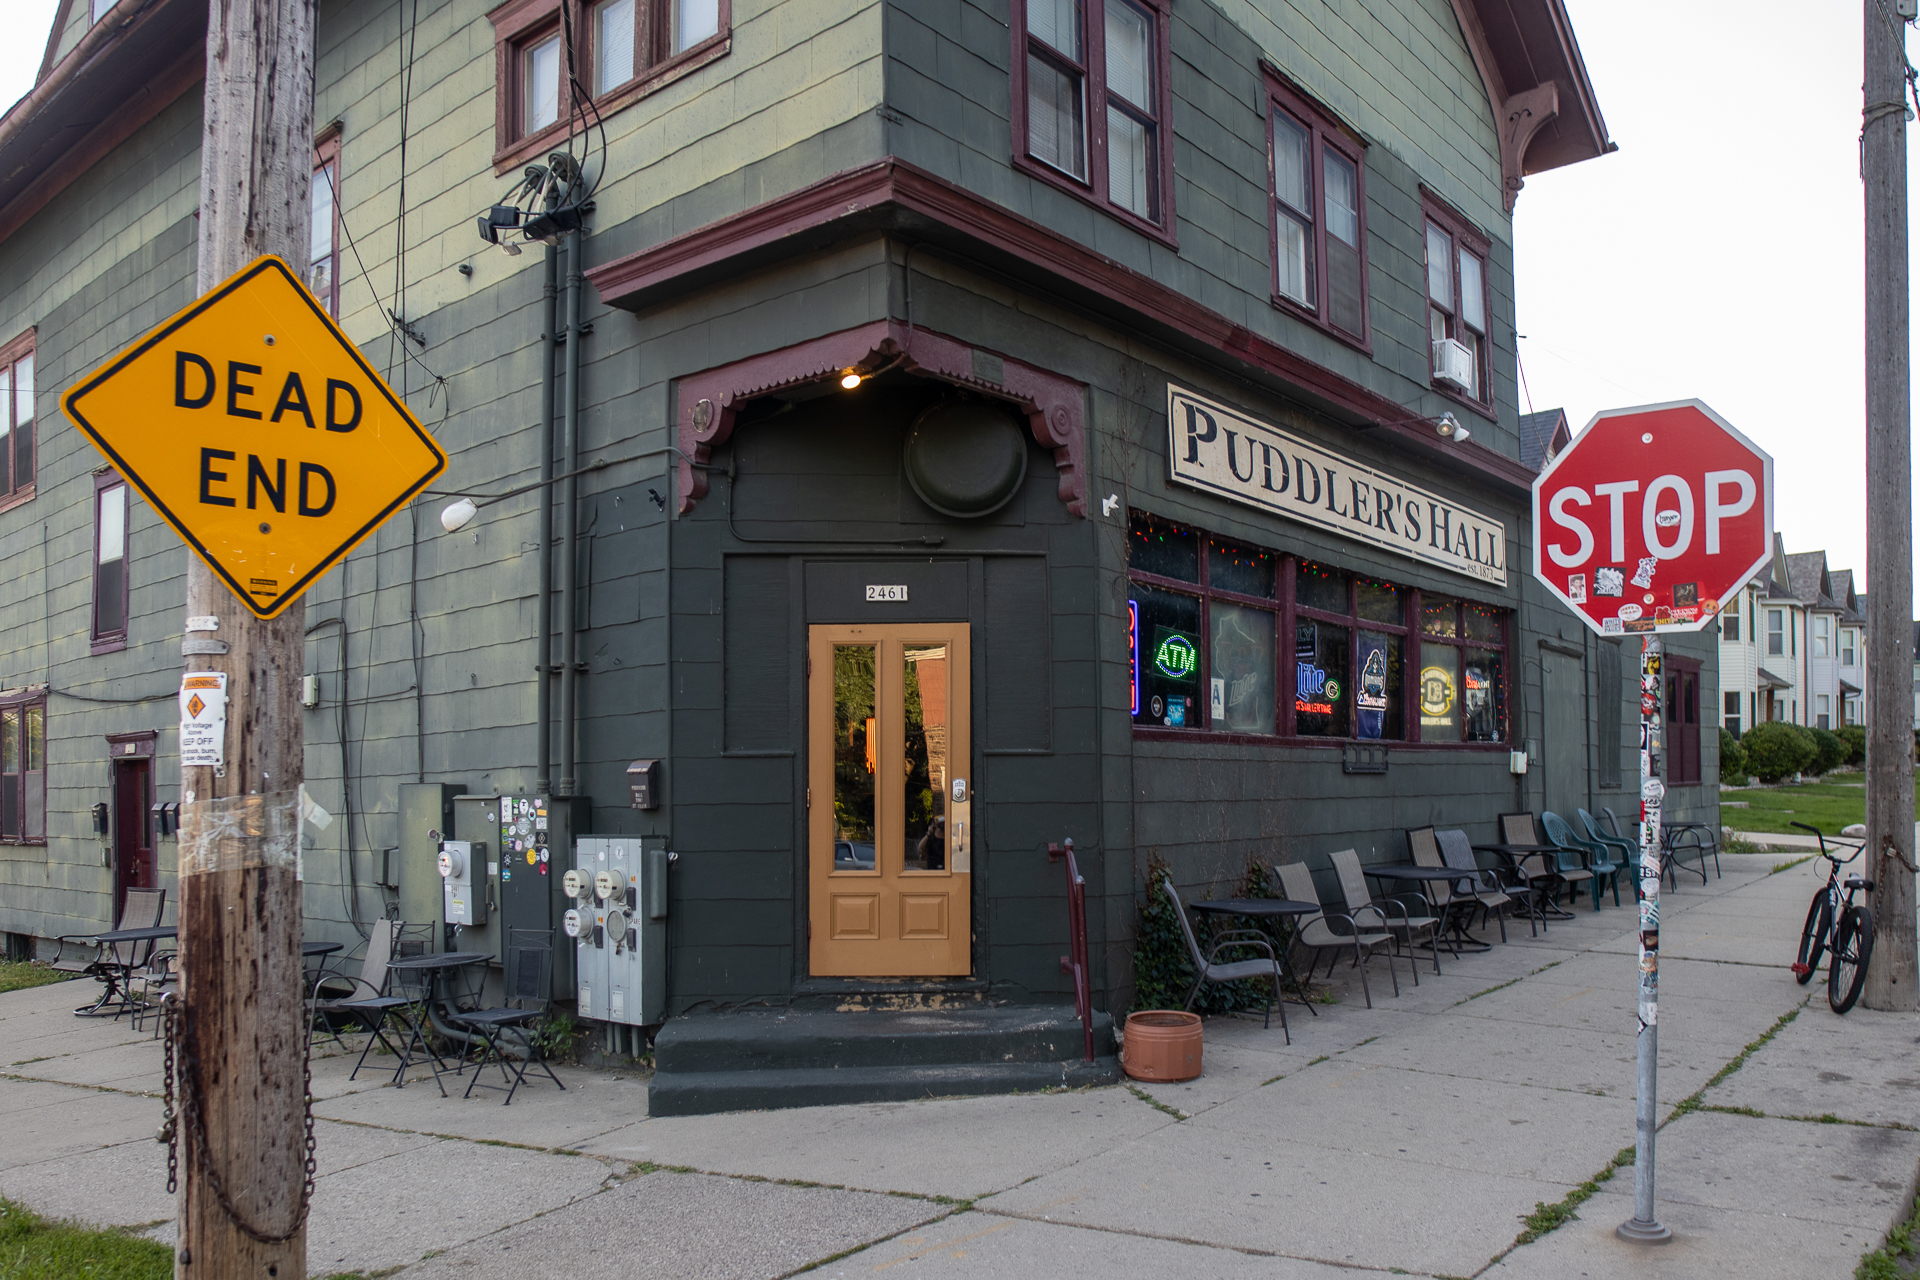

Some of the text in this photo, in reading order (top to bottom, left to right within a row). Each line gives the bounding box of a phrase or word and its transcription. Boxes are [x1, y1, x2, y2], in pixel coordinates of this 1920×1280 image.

[174, 351, 363, 433] DEAD
[199, 447, 336, 517] END
[1180, 400, 1503, 570] PUDDLER'S HALL
[1547, 468, 1757, 569] STOP
[1467, 564, 1494, 580] est. 1873
[868, 587, 904, 599] 2461
[1155, 642, 1196, 671] ATM
[1212, 684, 1222, 706] A
[1296, 662, 1325, 702] Lite
[197, 737, 214, 746] OFF
[628, 918, 640, 926] SPARE
